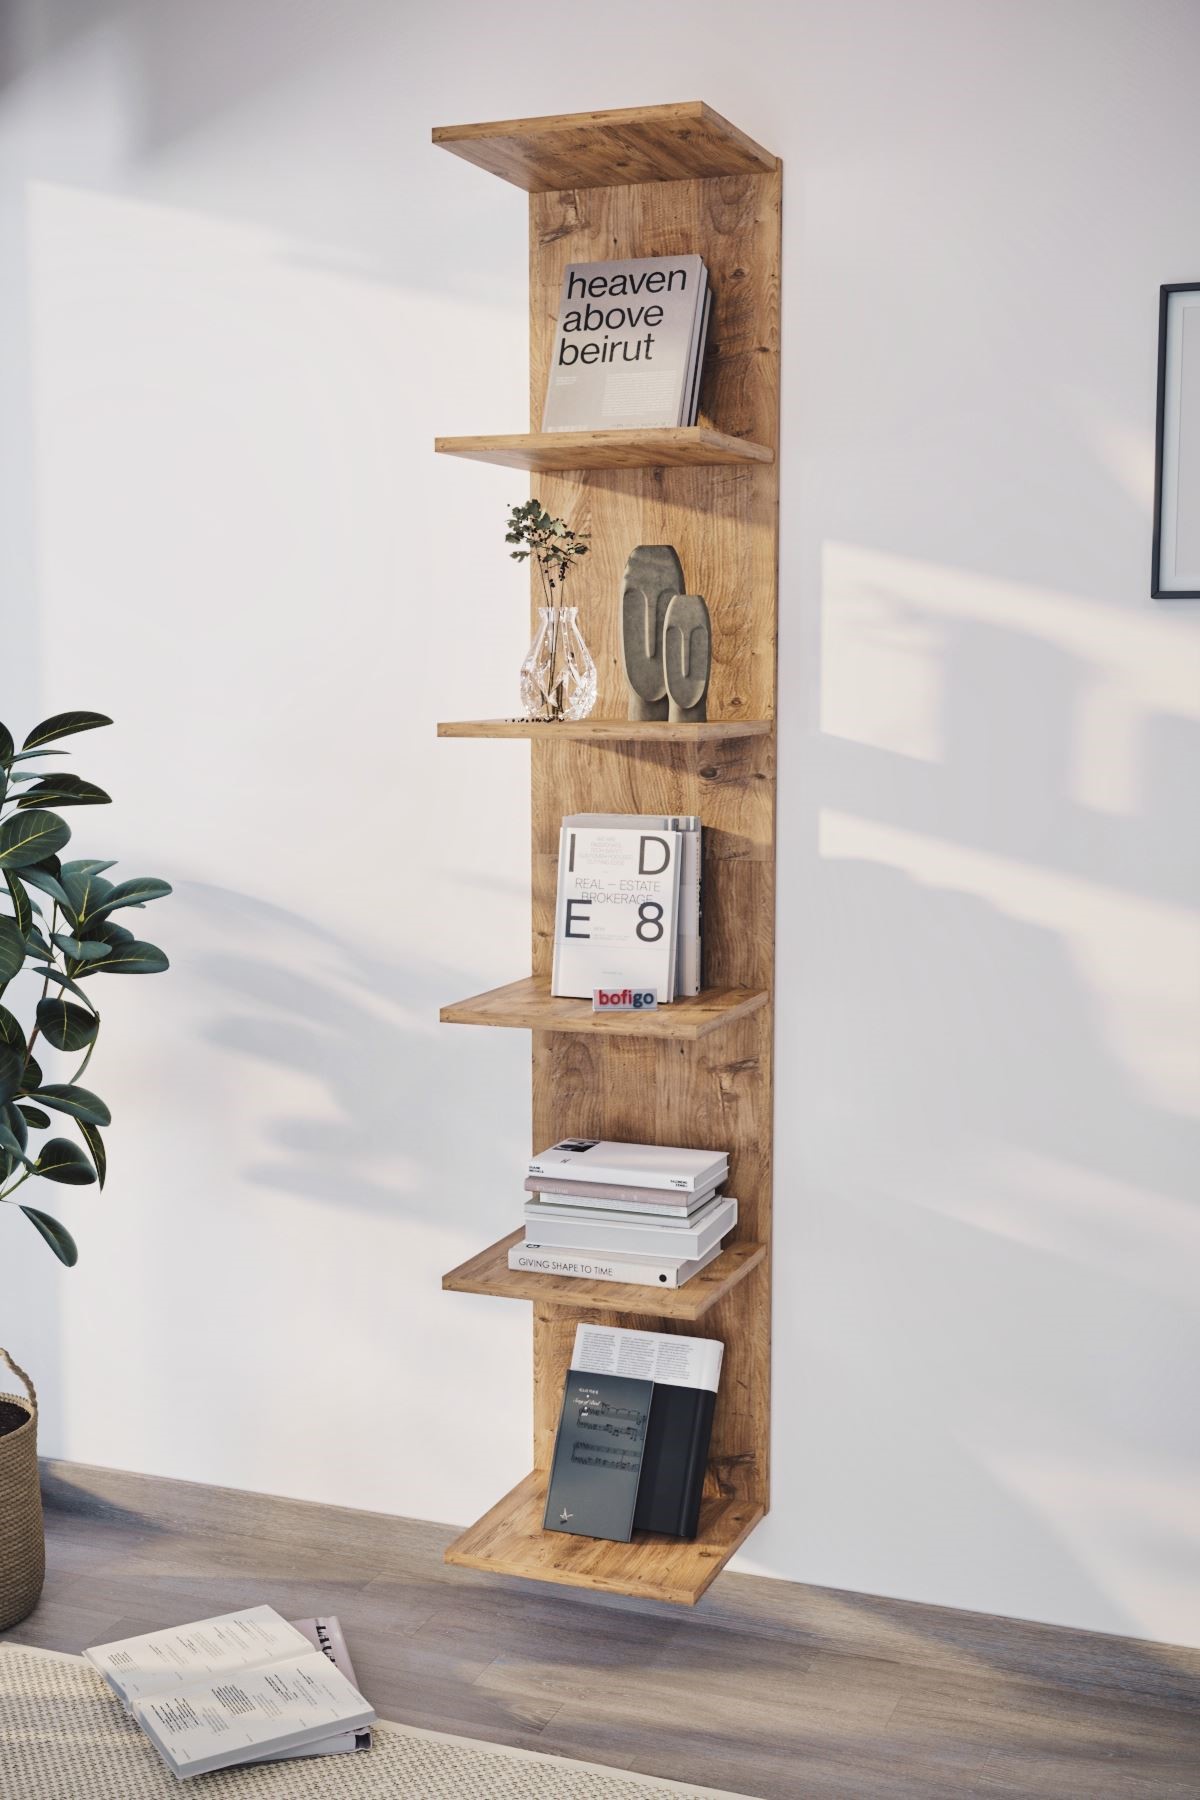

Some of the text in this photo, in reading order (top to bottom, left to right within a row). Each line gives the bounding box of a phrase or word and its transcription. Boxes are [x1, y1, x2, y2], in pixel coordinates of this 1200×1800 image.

[567, 269, 687, 299] heaven
[562, 303, 664, 333] above
[558, 333, 655, 366] beirut
[638, 835, 671, 875] D
[574, 877, 605, 890] REAL
[619, 879, 662, 892] ESTATE
[581, 891, 654, 905] BROKERAGE
[565, 898, 664, 943] E 8
[518, 1257, 613, 1276] GIVING SHAPE TO TIME
